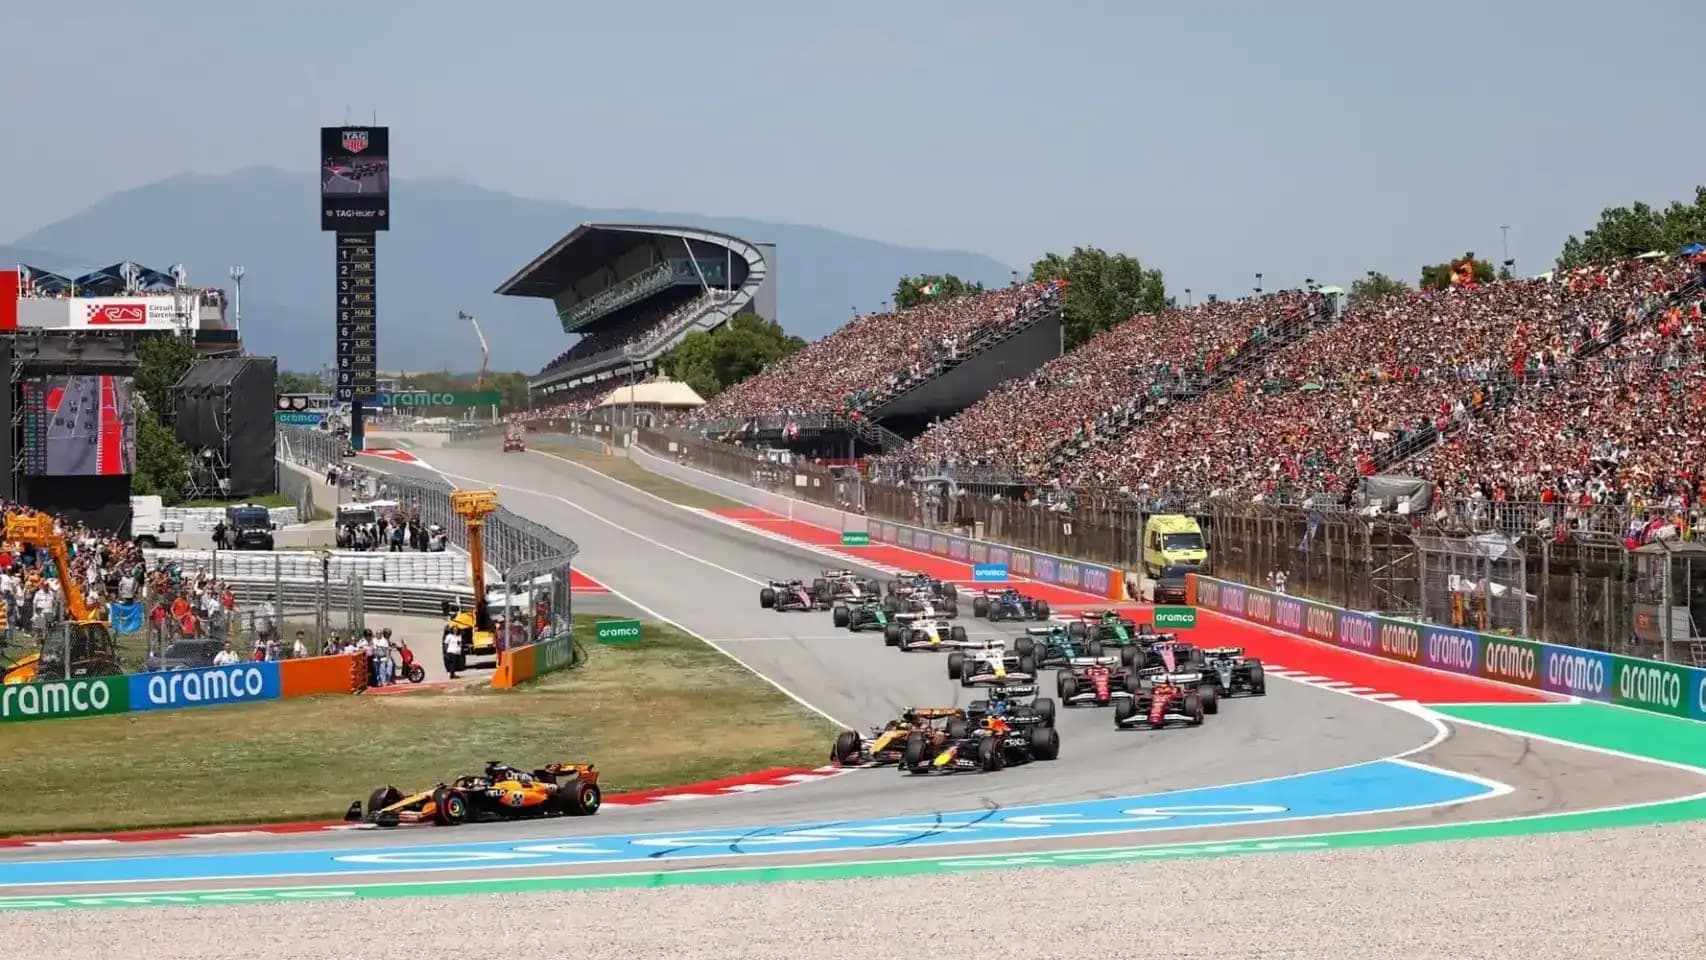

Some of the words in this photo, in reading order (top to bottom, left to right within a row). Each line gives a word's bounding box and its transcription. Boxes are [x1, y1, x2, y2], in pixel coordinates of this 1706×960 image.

[341, 250, 347, 259] 1
[341, 265, 348, 275] 2
[341, 281, 348, 290] 3
[341, 296, 348, 305] 4
[342, 311, 348, 320] 5
[341, 327, 348, 336] 6
[341, 342, 348, 351] 7
[341, 358, 348, 367] 8
[341, 373, 348, 383] 9
[340, 388, 351, 398] 10
[382, 393, 455, 406] aramco
[975, 568, 1006, 576] aramco
[1156, 613, 1194, 622] aramco
[1307, 607, 1334, 639] aramco
[600, 628, 638, 637] aramco
[1341, 616, 1372, 649] aramco
[1381, 624, 1418, 658] aramco
[1428, 633, 1473, 669] aramco
[1486, 642, 1535, 680] aramco
[1550, 653, 1603, 694] aramco
[149, 668, 263, 704] aramco
[1620, 664, 1680, 708] aramco
